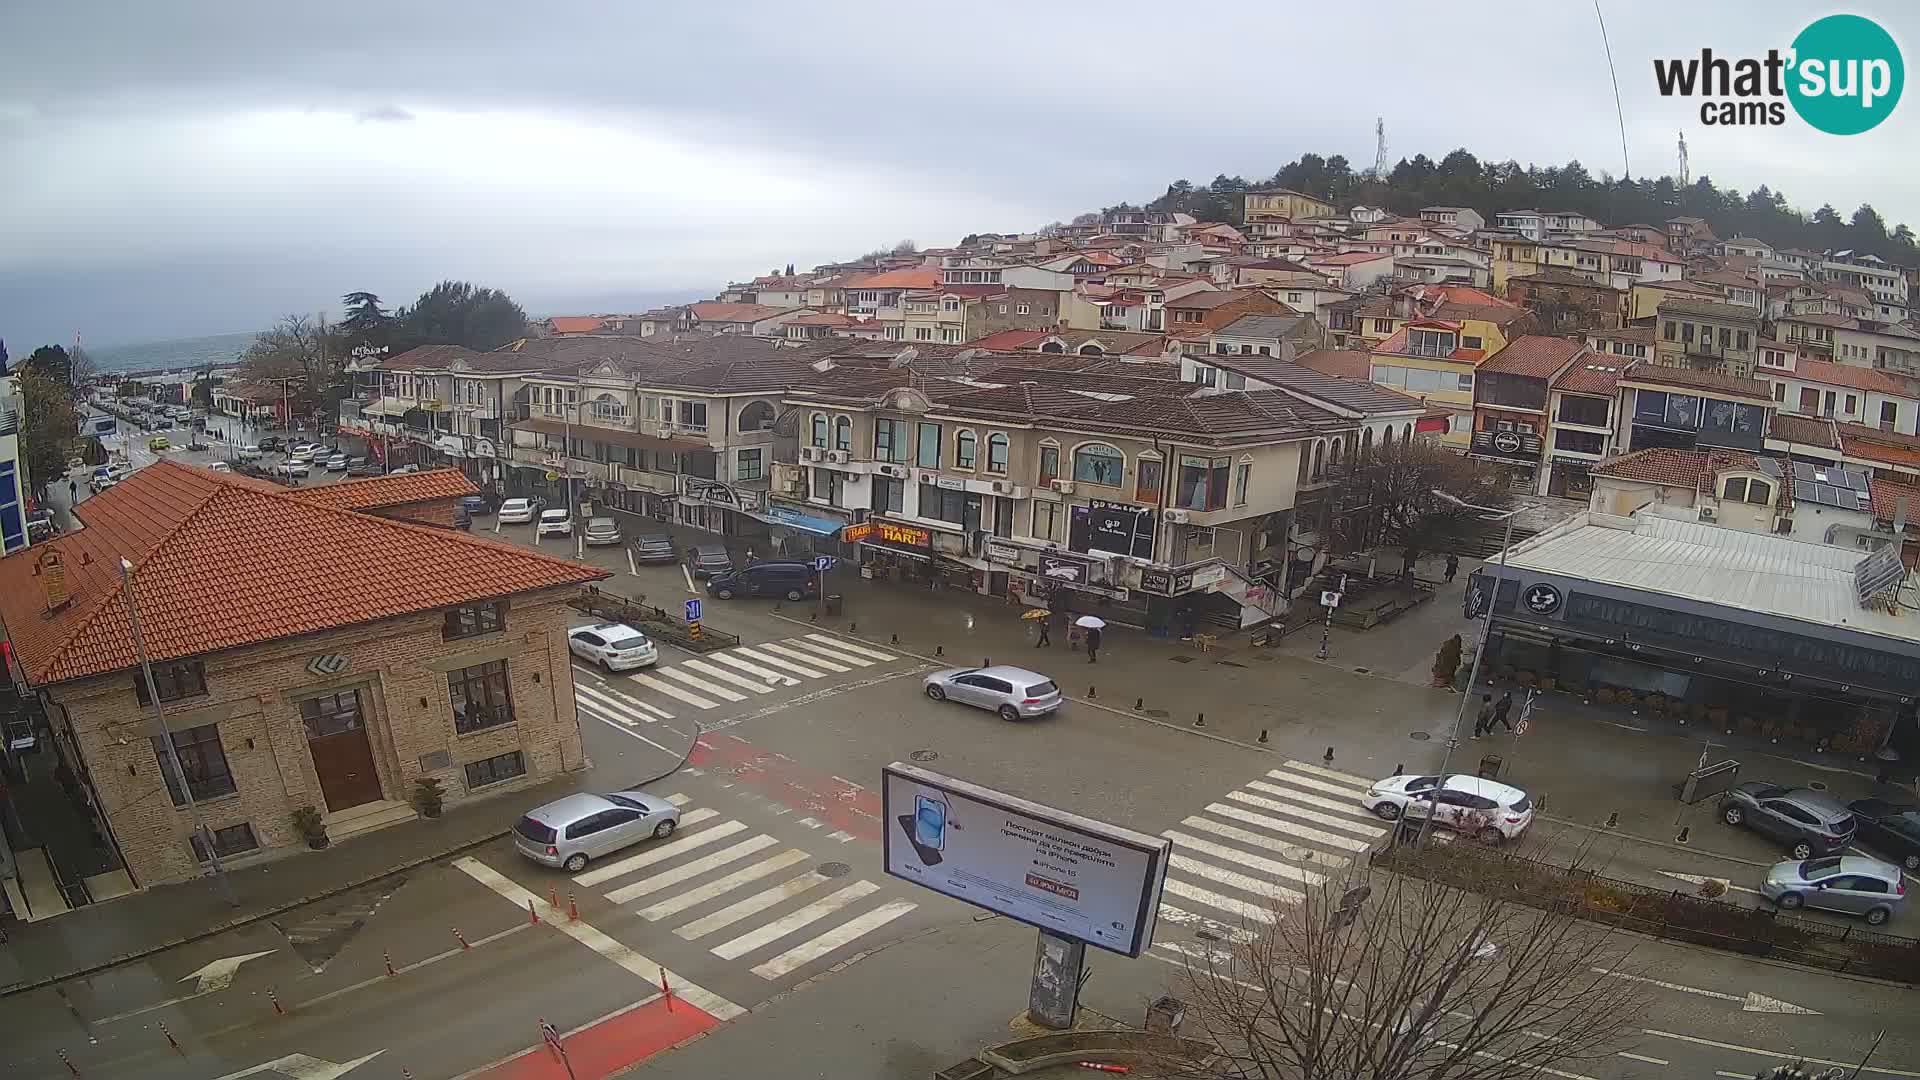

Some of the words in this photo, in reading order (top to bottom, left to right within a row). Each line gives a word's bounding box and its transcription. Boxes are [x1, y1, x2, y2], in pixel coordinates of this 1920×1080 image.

[1001, 828, 1038, 844] причини
[1039, 840, 1050, 849] да
[1006, 820, 1044, 837] Постојат
[1045, 834, 1081, 849] милион
[1081, 845, 1112, 858] добри
[1049, 851, 1079, 865] iPhone
[1040, 862, 1066, 874] iPhone
[1067, 870, 1078, 878] 15
